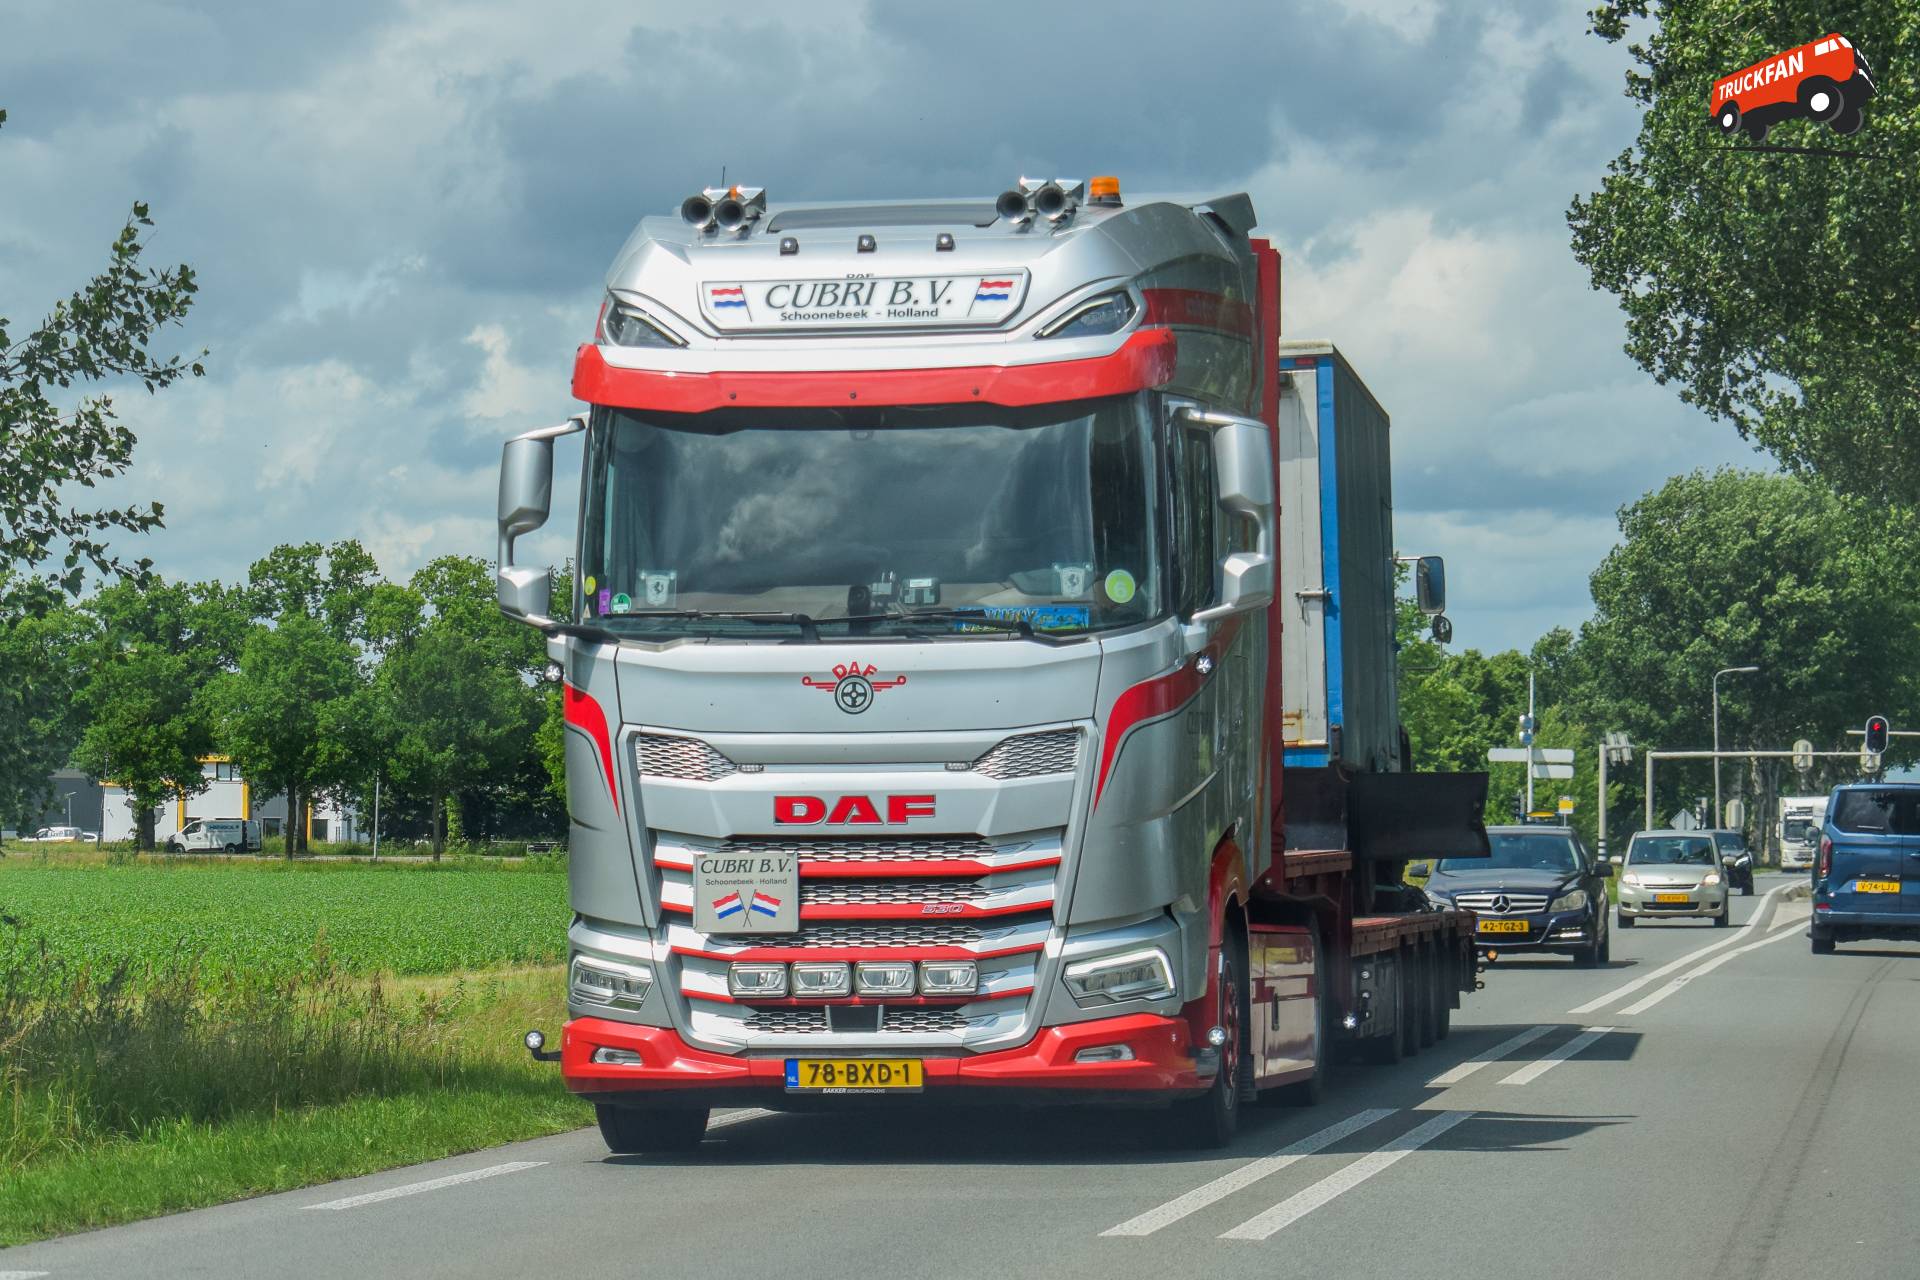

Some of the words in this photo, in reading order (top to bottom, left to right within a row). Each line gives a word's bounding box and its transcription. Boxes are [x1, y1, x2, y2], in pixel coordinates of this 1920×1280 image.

[765, 282, 878, 309] CUBRI
[780, 309, 868, 321] Schoonebeek
[887, 307, 939, 318] Holland
[832, 661, 878, 680] DAF
[774, 795, 937, 825] DAF
[700, 859, 754, 874] CUBRI
[705, 878, 754, 886] Schoonebeek
[922, 904, 964, 914] 530
[808, 1063, 910, 1085] 78-BXD-1
